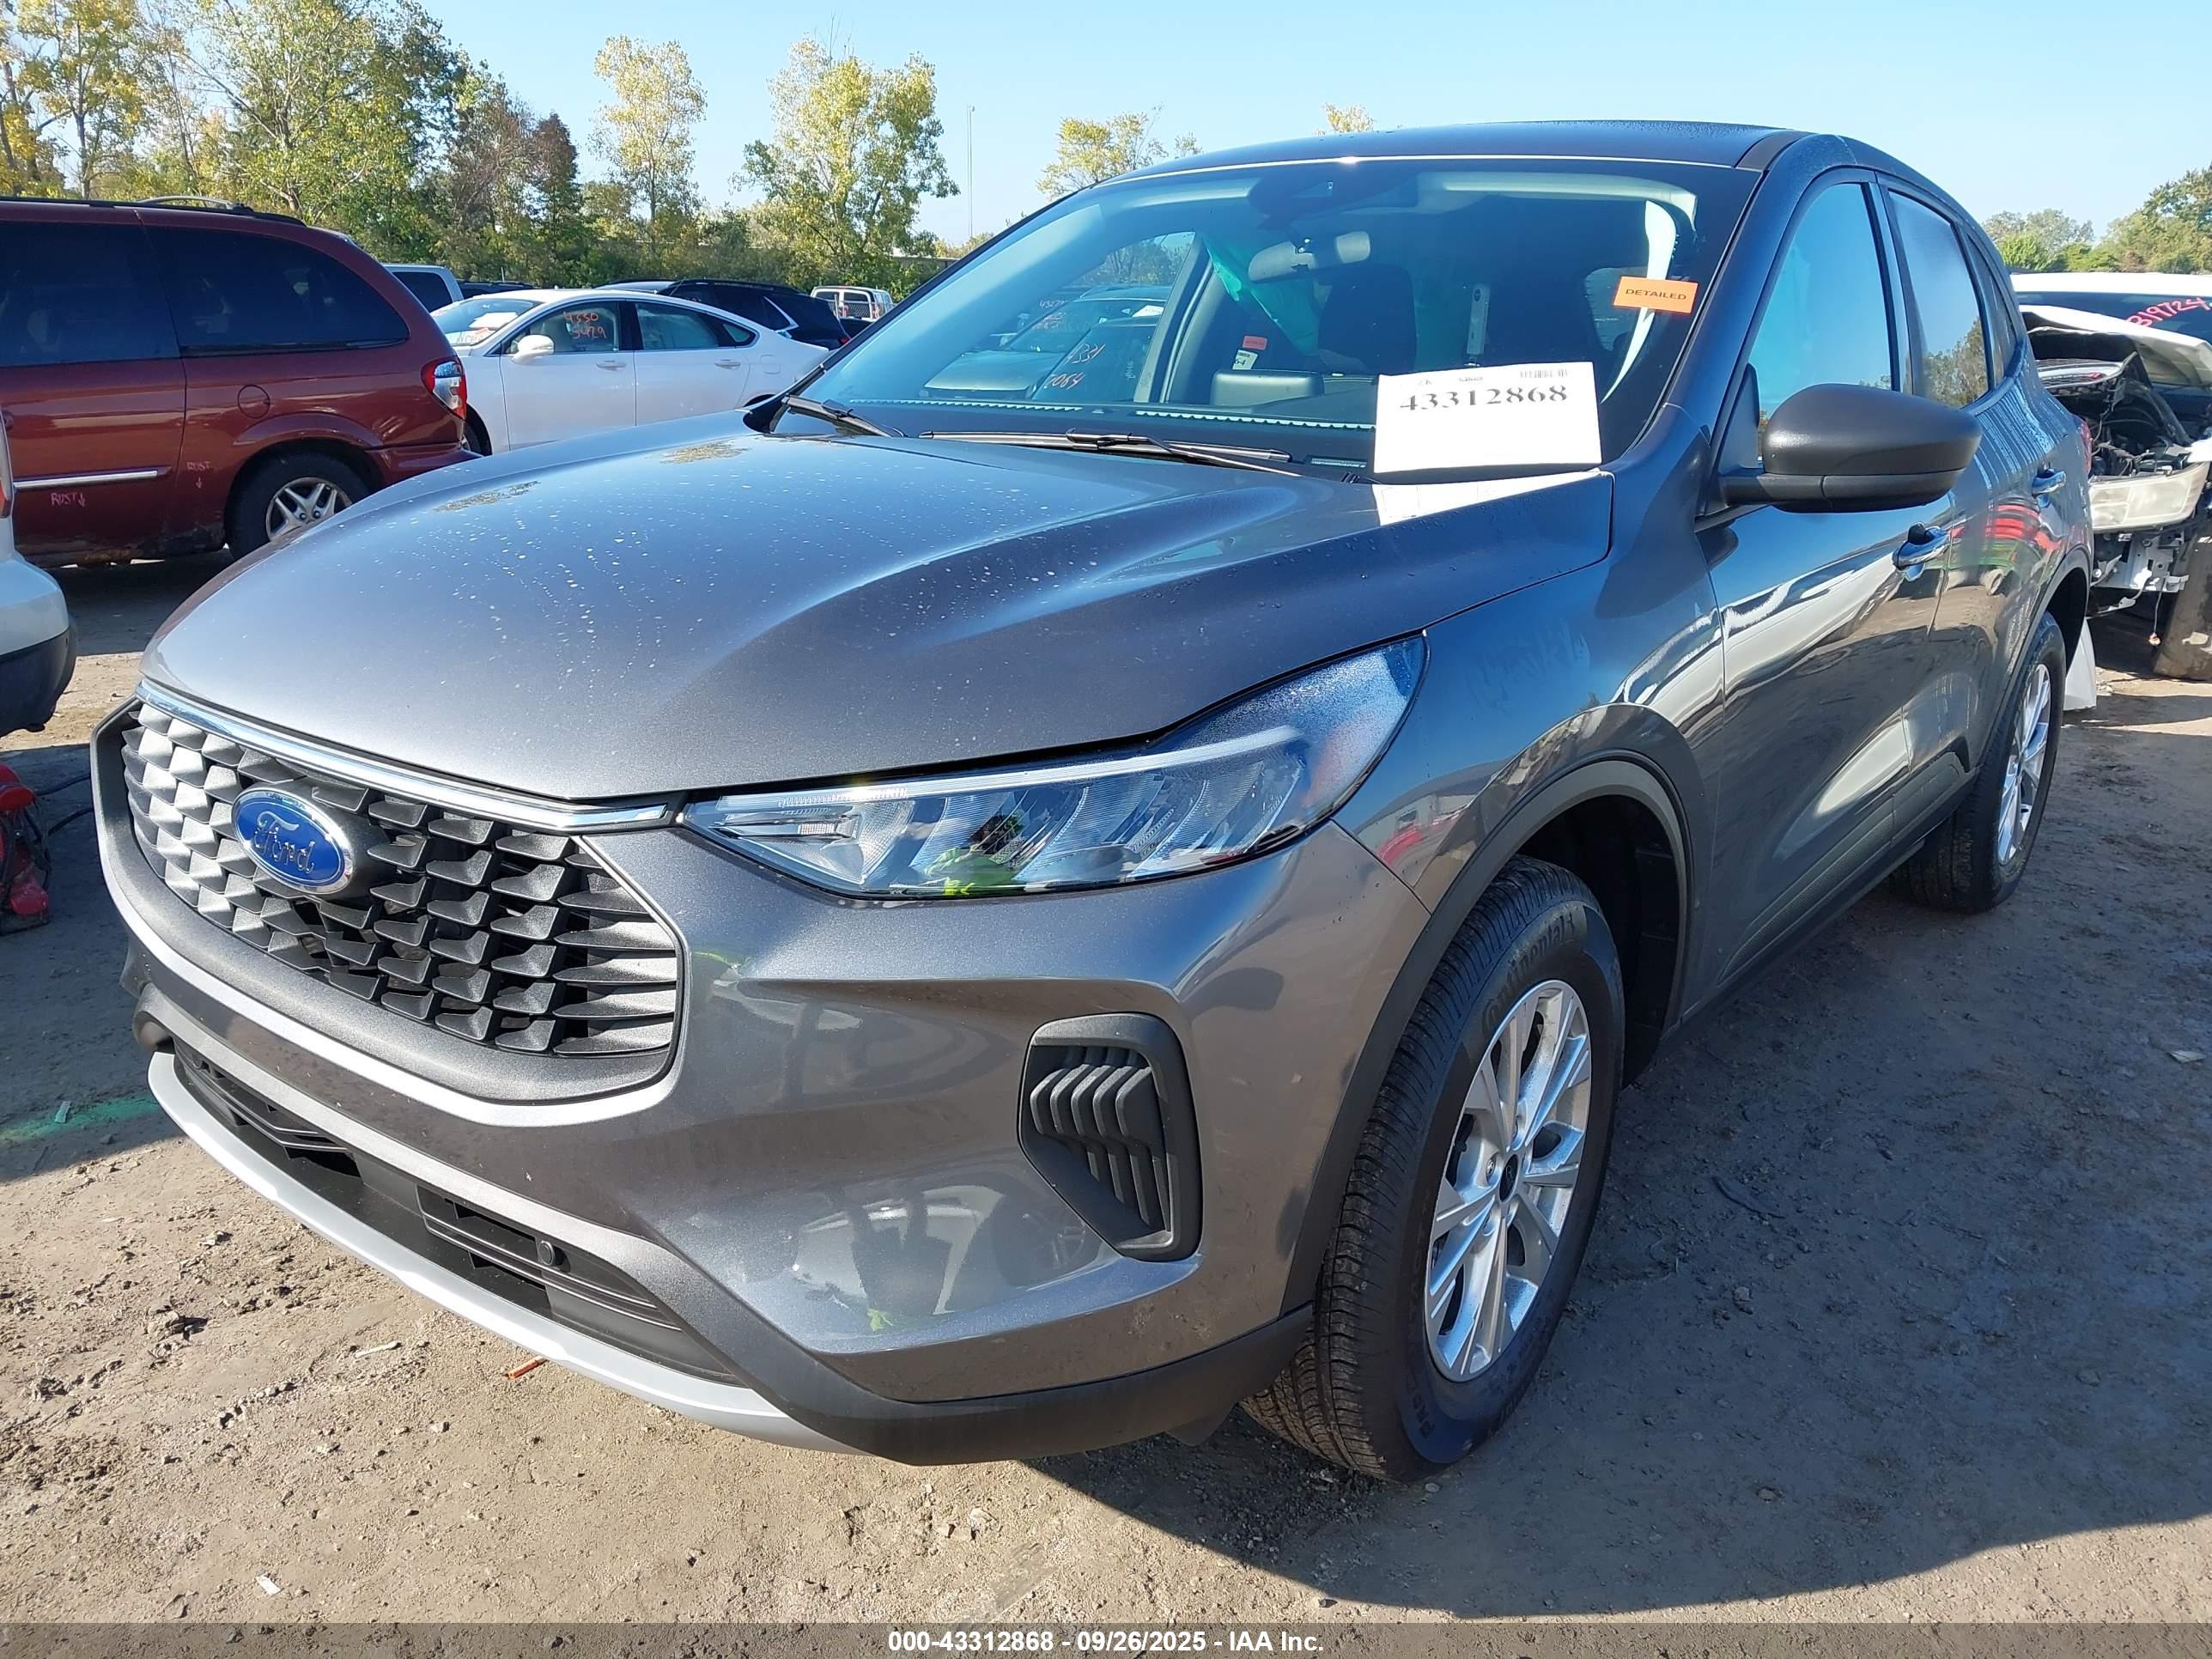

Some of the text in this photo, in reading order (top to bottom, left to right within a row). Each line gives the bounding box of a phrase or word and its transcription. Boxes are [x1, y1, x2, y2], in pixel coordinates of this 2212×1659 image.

[1626, 289, 1686, 301] DETAILED
[1400, 385, 1567, 411] 43312868
[186, 460, 211, 471] RUST
[50, 492, 76, 507] RUST
[254, 811, 316, 874] Ford
